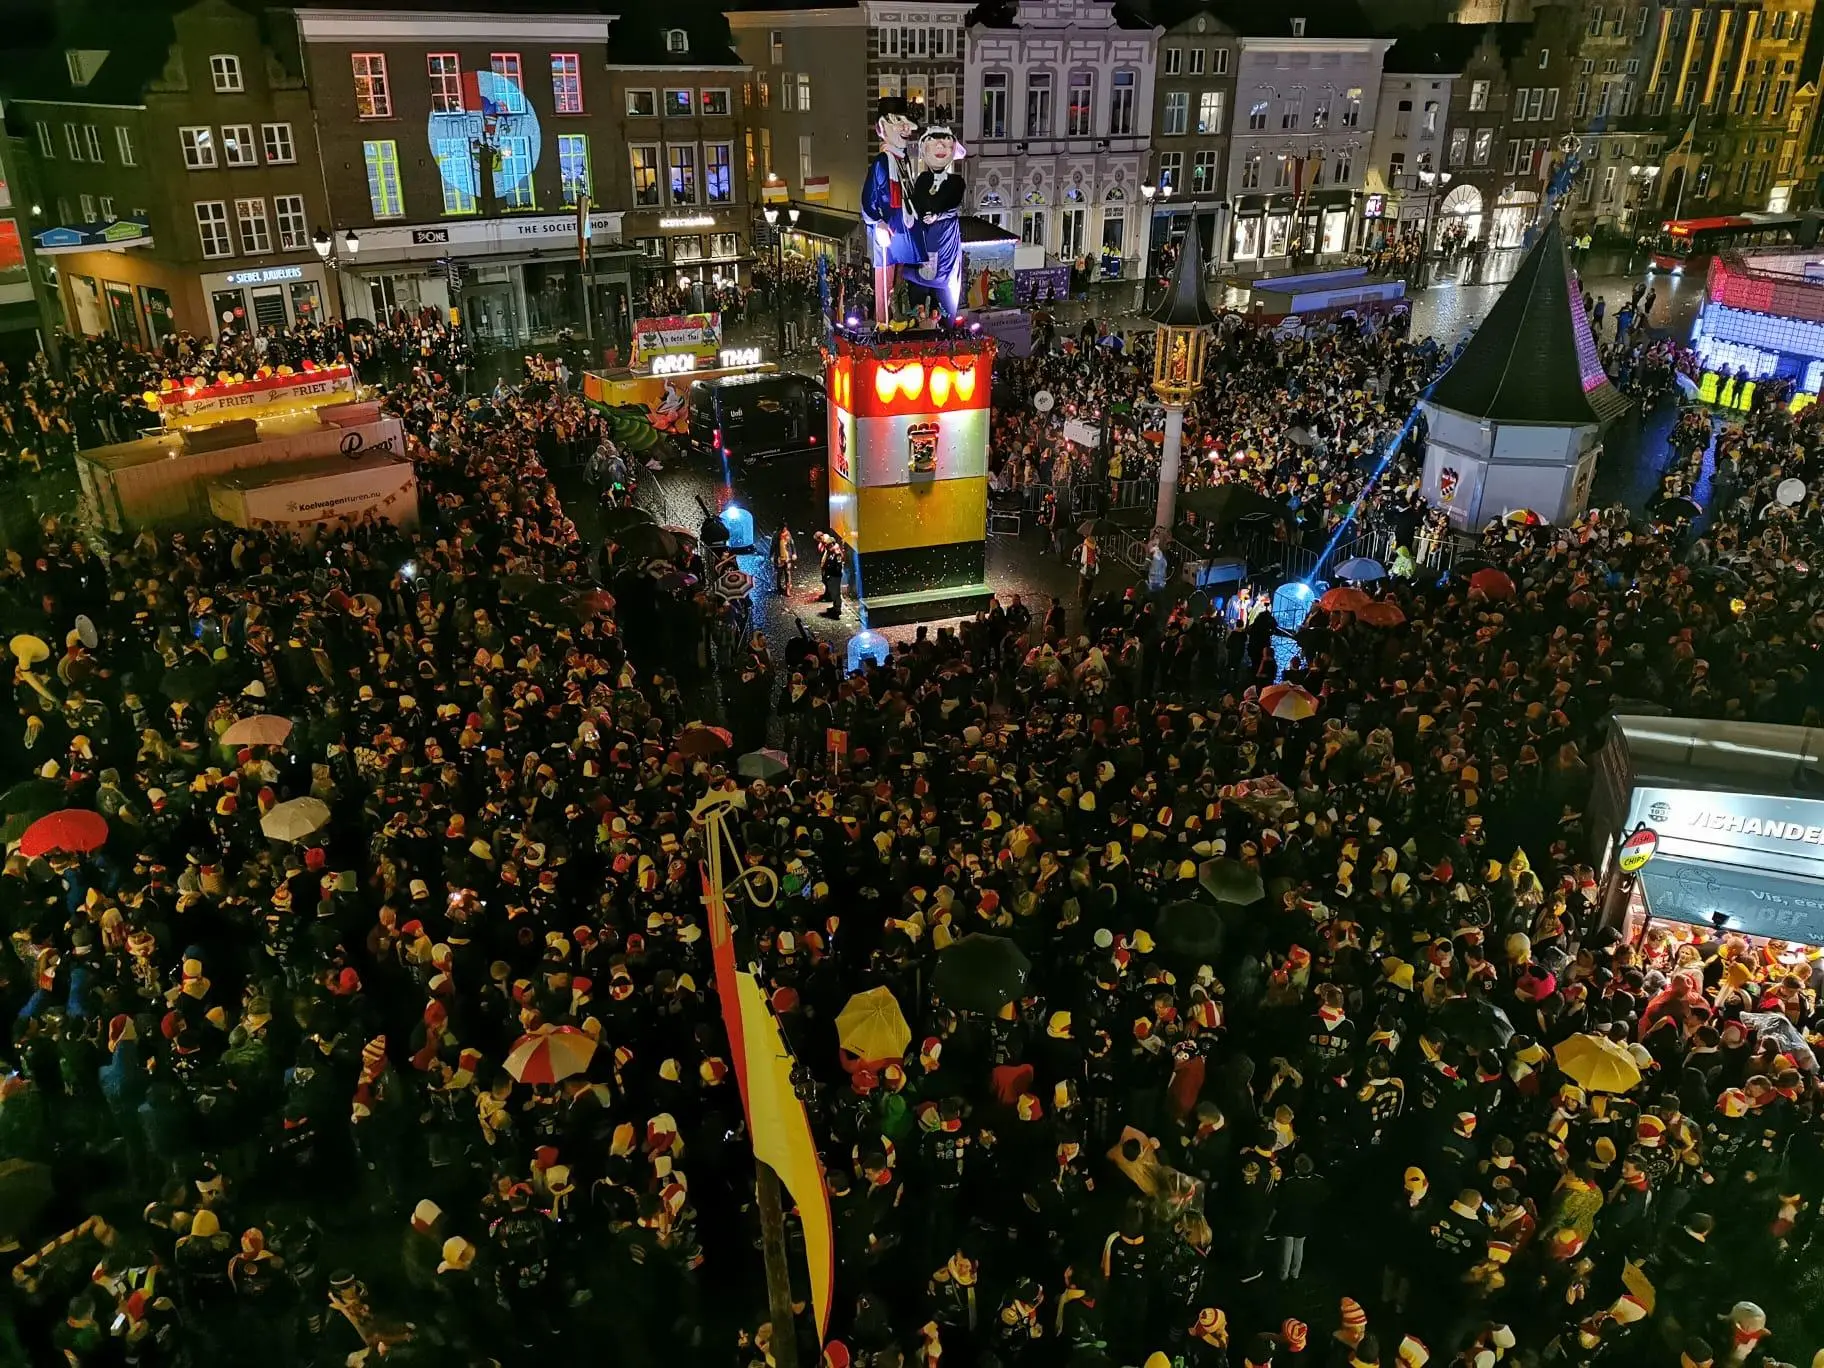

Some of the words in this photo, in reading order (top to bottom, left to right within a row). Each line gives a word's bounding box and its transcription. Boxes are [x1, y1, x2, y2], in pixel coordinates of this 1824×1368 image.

[518, 225, 537, 234] THE
[543, 223, 577, 232] SOCIET
[590, 221, 609, 229] HOP
[236, 271, 262, 283] SIEBEL
[652, 353, 694, 374] AROI
[720, 347, 759, 367] THAI
[293, 383, 327, 397] FRIET
[219, 394, 255, 408] FRIET
[1632, 834, 1650, 844] FISH
[1624, 855, 1646, 866] CHIPS
